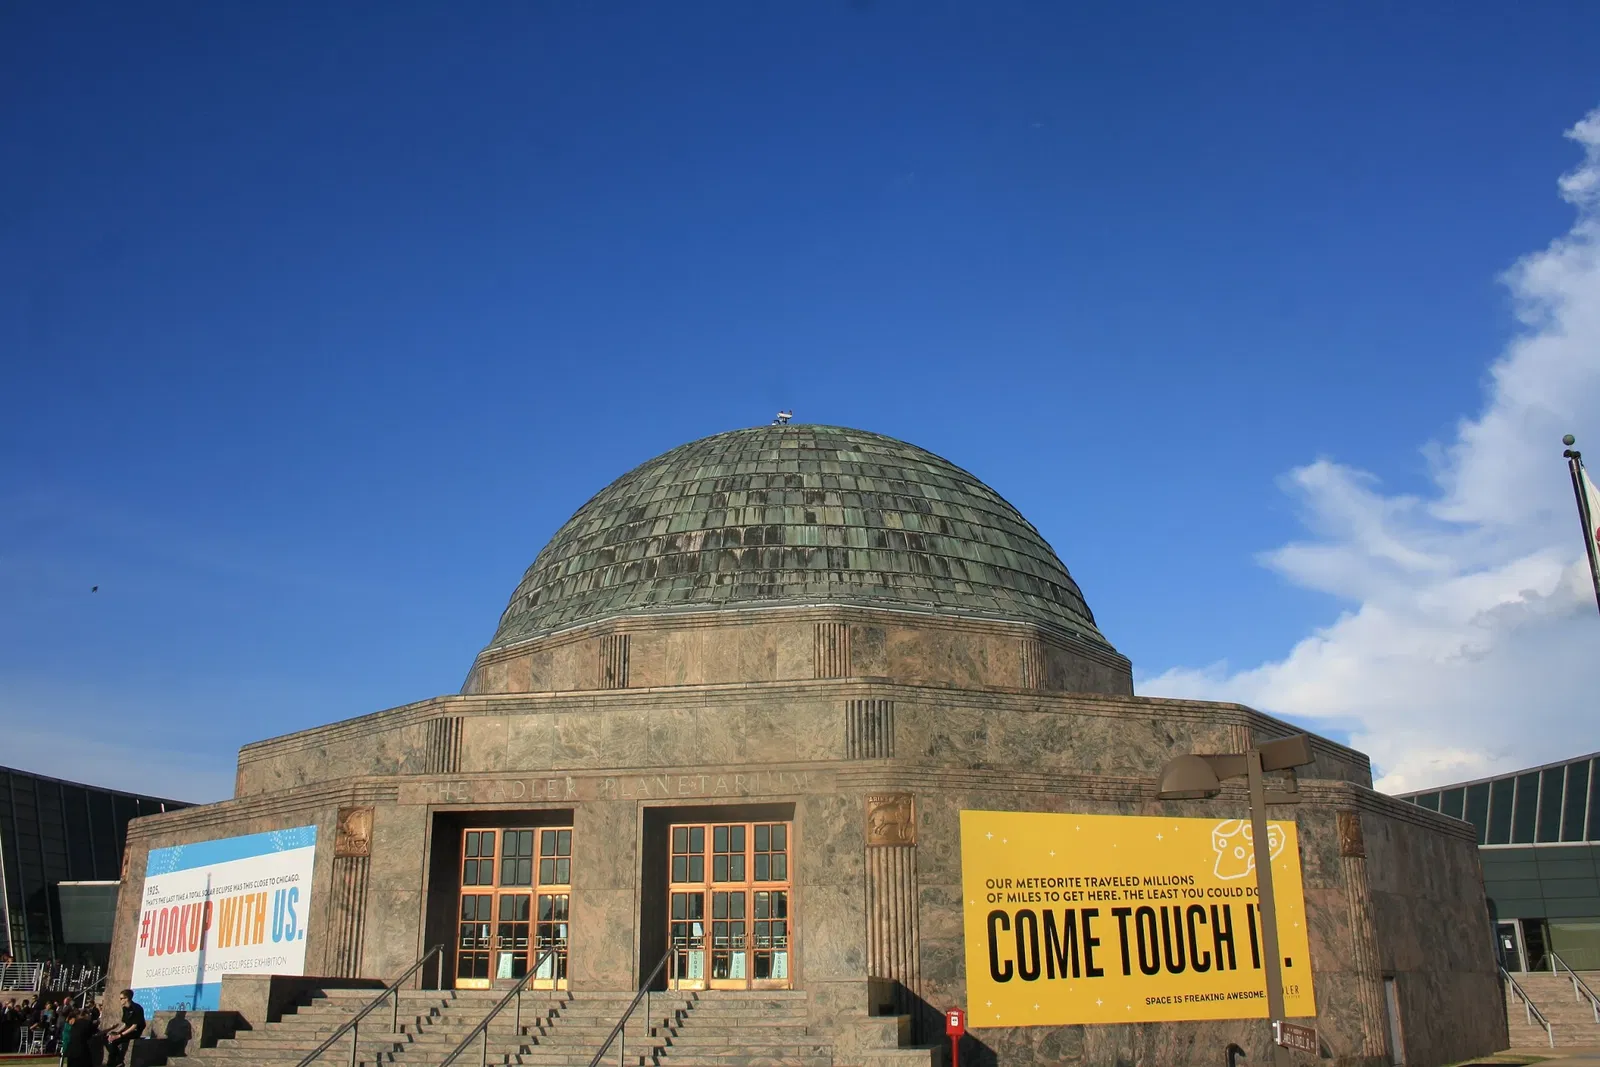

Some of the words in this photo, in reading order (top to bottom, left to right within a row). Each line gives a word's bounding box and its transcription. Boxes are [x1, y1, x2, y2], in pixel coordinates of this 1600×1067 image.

[493, 778, 578, 800] ADLER
[604, 770, 810, 797] PLANETARIUM
[253, 878, 269, 888] CLOSE
[269, 877, 276, 885] TO
[985, 878, 1013, 889] OUR
[1016, 877, 1082, 889] METEORITE
[1084, 876, 1140, 888] TRAVELED
[1143, 875, 1195, 886] MILLIONS
[986, 892, 1003, 903] OF
[1007, 891, 1042, 903] MILES
[1044, 891, 1060, 902] TO
[1063, 890, 1084, 902] GET
[1088, 890, 1121, 901] HERE.
[1123, 889, 1144, 900] THE
[1147, 888, 1178, 899] LEAST
[1181, 888, 1204, 898] YOU
[1207, 887, 1243, 898] COULD
[140, 901, 213, 956] #LOOKUP
[217, 891, 268, 949] WITH
[271, 886, 304, 943] US.
[986, 908, 1105, 983] COME
[1111, 903, 1237, 976] TOUCH
[1246, 903, 1292, 970] I.
[1145, 996, 1172, 1005] SPACE
[1173, 995, 1182, 1004] IS
[1184, 993, 1225, 1003] FREAKING
[1226, 990, 1267, 1000] AWESOME.
[1282, 985, 1300, 995] LER
